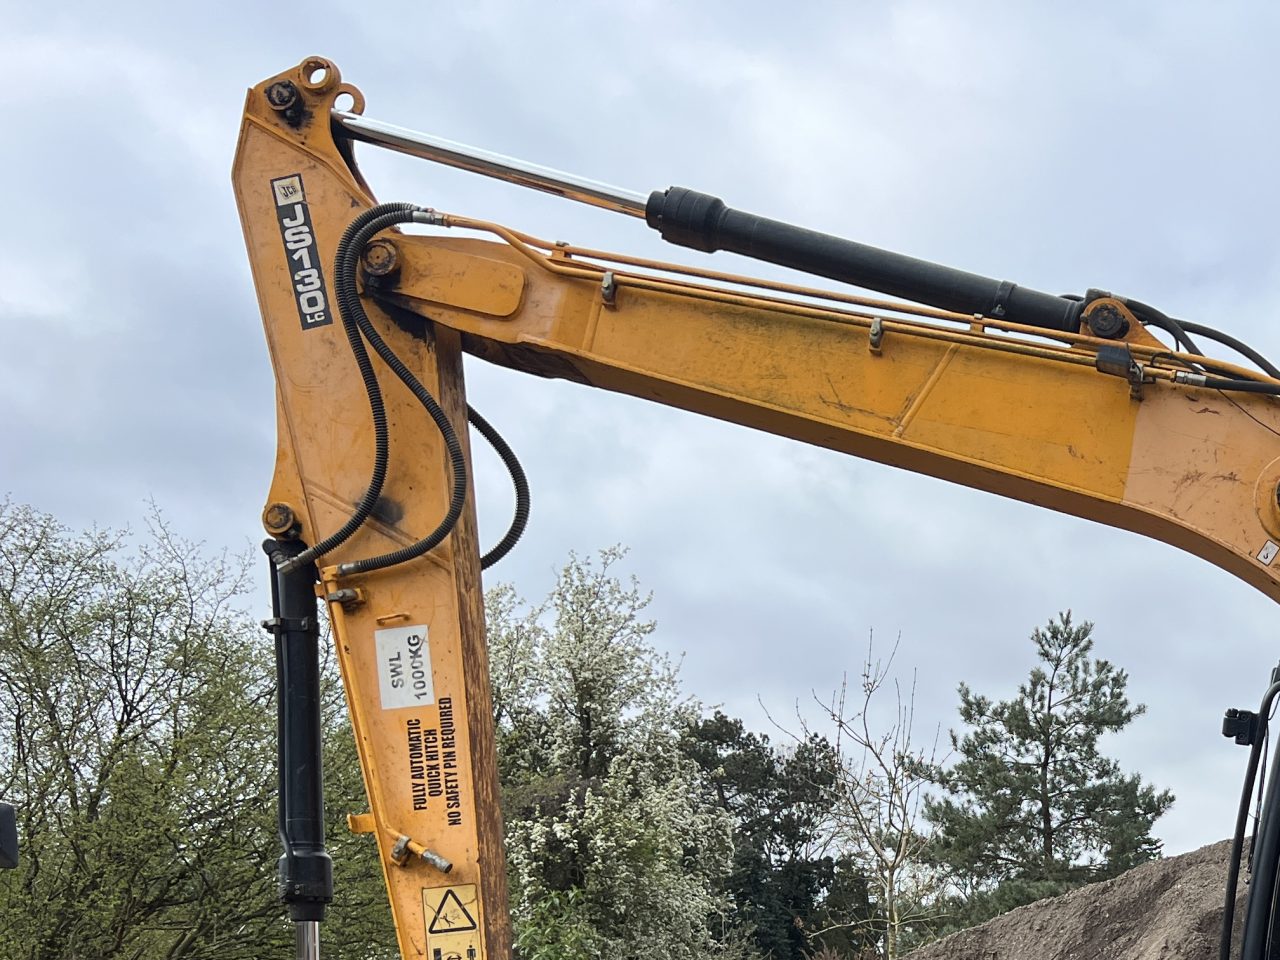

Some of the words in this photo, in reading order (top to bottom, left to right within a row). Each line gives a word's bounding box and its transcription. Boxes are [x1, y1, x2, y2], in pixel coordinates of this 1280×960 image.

[389, 651, 405, 689] SWL
[407, 635, 427, 700] 1000KG
[438, 697, 455, 749] REQUIRED
[407, 718, 425, 779] AUTOMATIC
[424, 729, 439, 761] HITCH
[442, 751, 457, 769] PIN
[412, 783, 427, 811] FULLY
[426, 763, 443, 797] QUICK
[444, 771, 460, 808] SAFETY
[447, 811, 462, 826] NO
